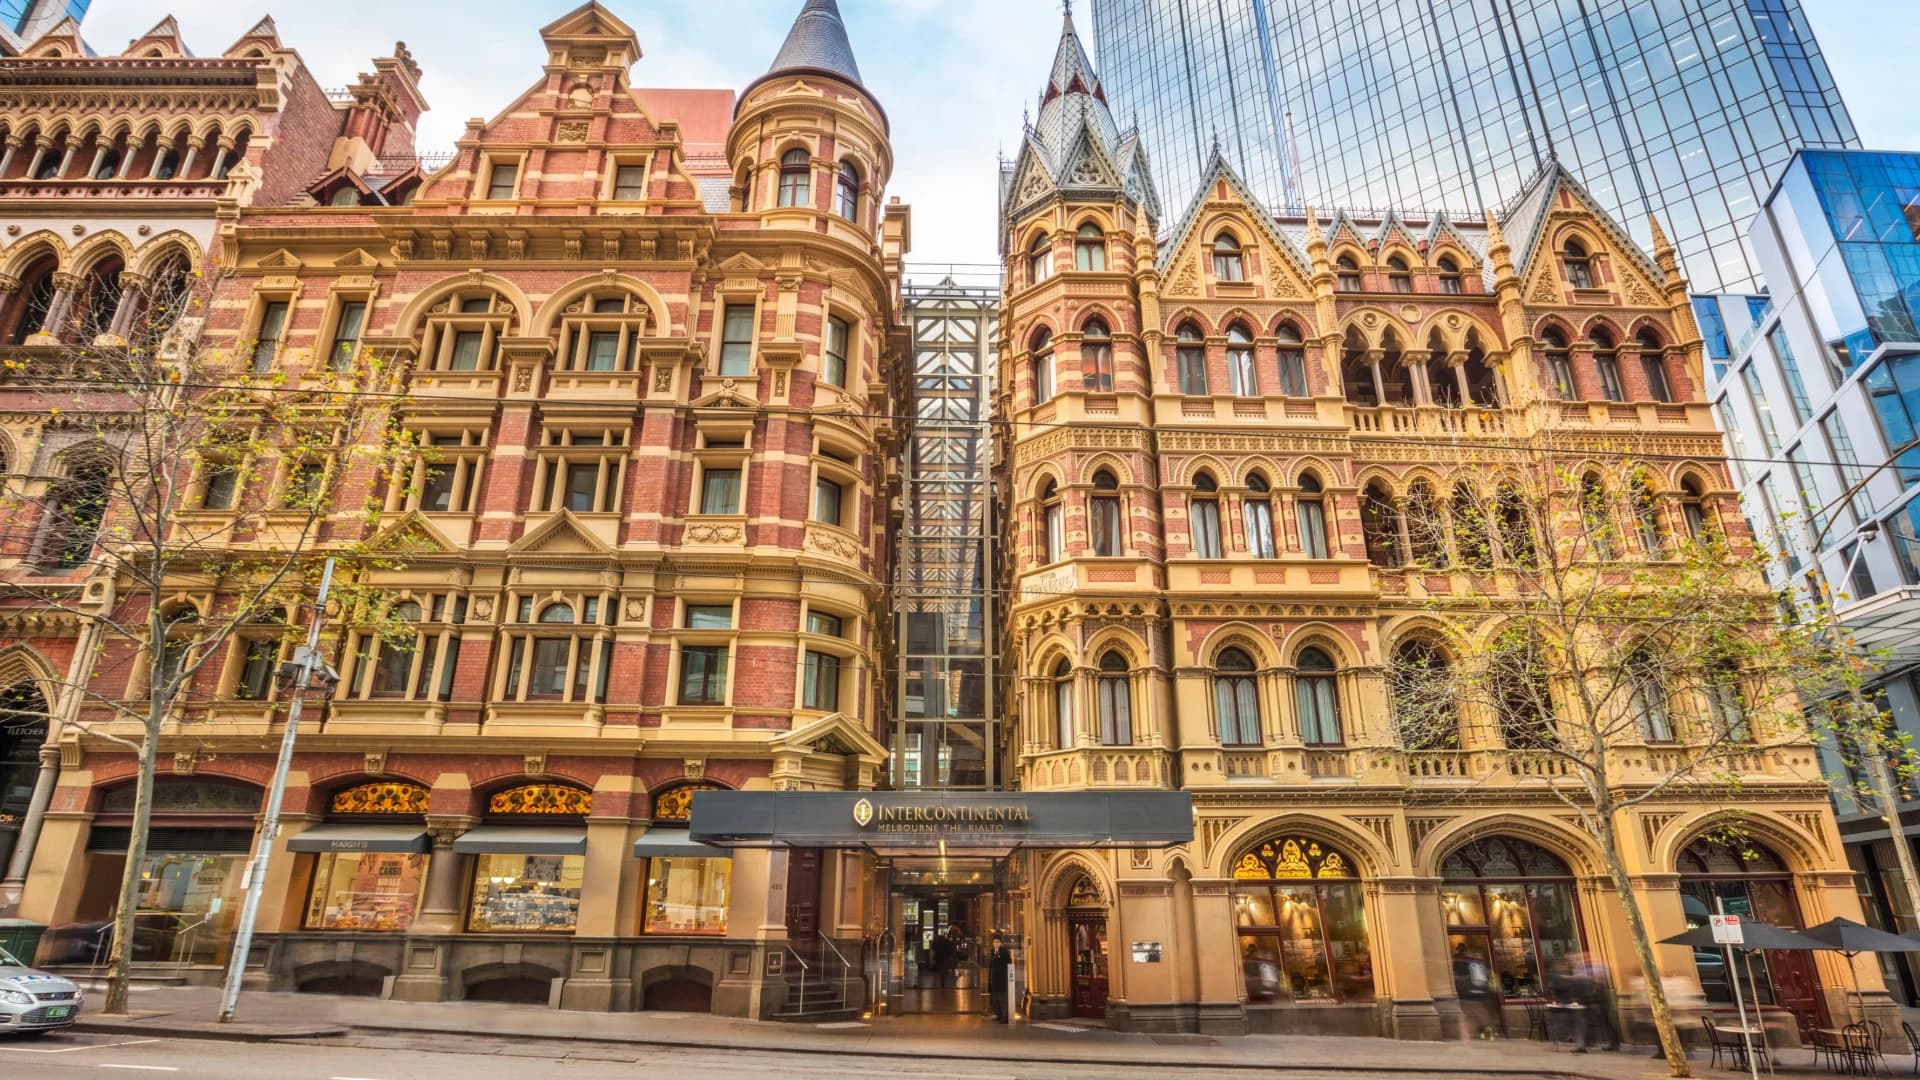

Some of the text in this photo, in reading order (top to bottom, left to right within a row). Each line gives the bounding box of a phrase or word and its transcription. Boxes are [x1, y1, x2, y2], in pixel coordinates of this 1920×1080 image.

[878, 804, 1034, 821] INTERCONTINENTAL
[877, 824, 1004, 832] MELBOURNE THE RIALTO
